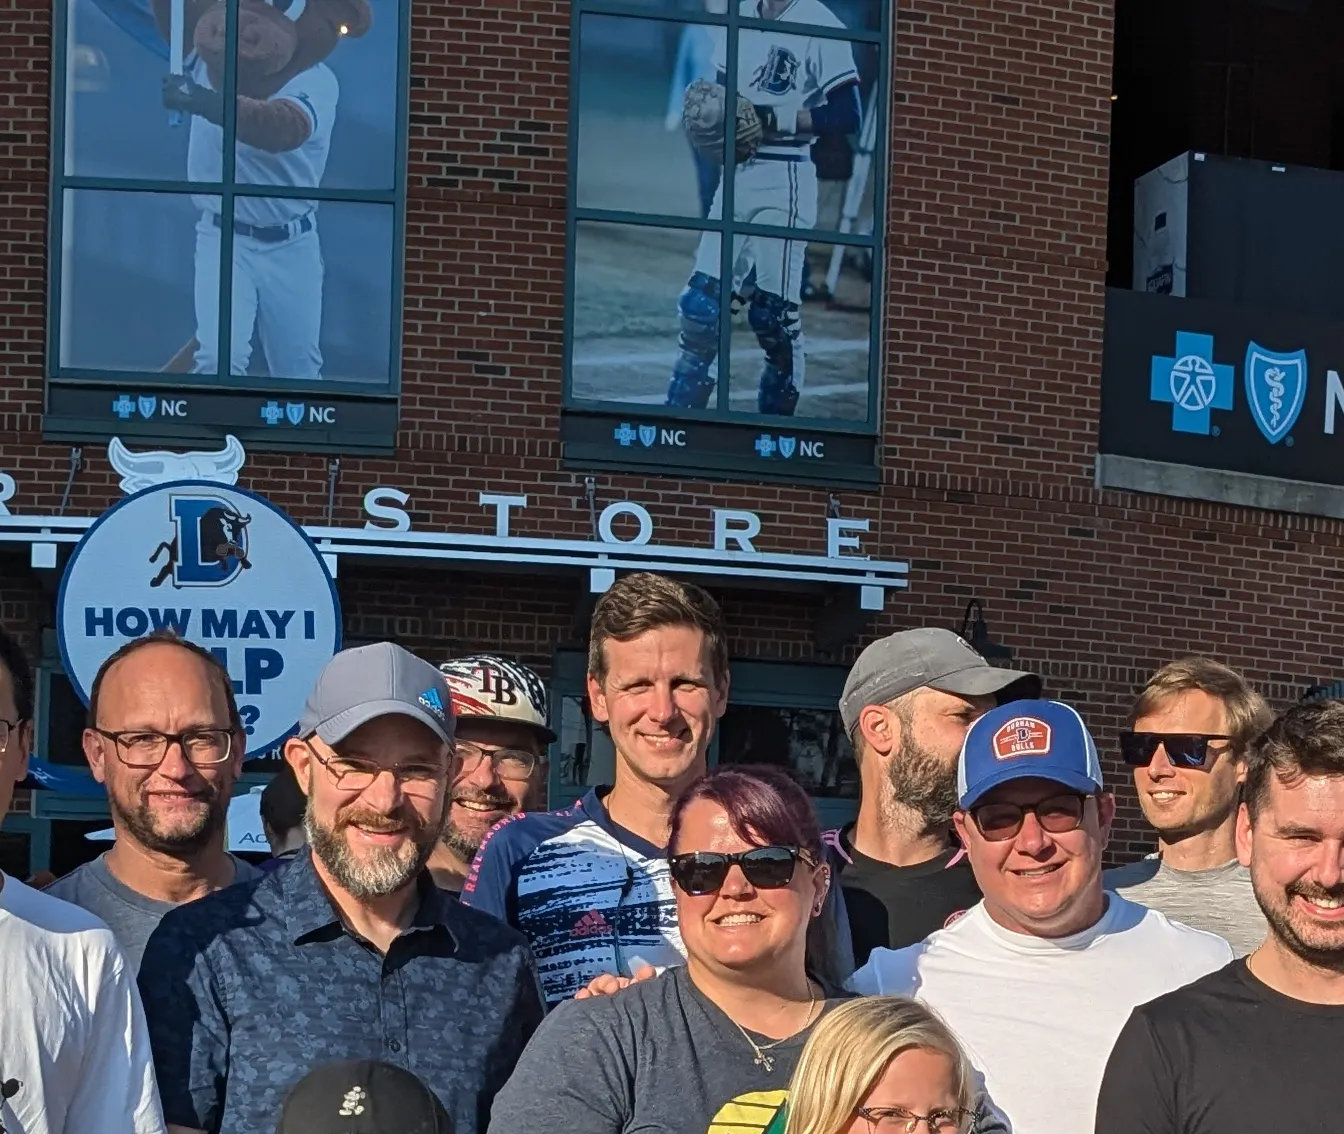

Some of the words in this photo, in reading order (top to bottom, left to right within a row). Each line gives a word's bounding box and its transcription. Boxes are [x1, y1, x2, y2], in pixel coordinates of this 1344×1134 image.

[162, 400, 187, 416] NC
[310, 407, 335, 423] NC
[662, 430, 686, 446] NC
[800, 441, 824, 457] NC
[364, 487, 871, 560] STORE
[85, 607, 191, 637] HOW
[202, 609, 295, 639] MAY
[304, 610, 315, 639] I
